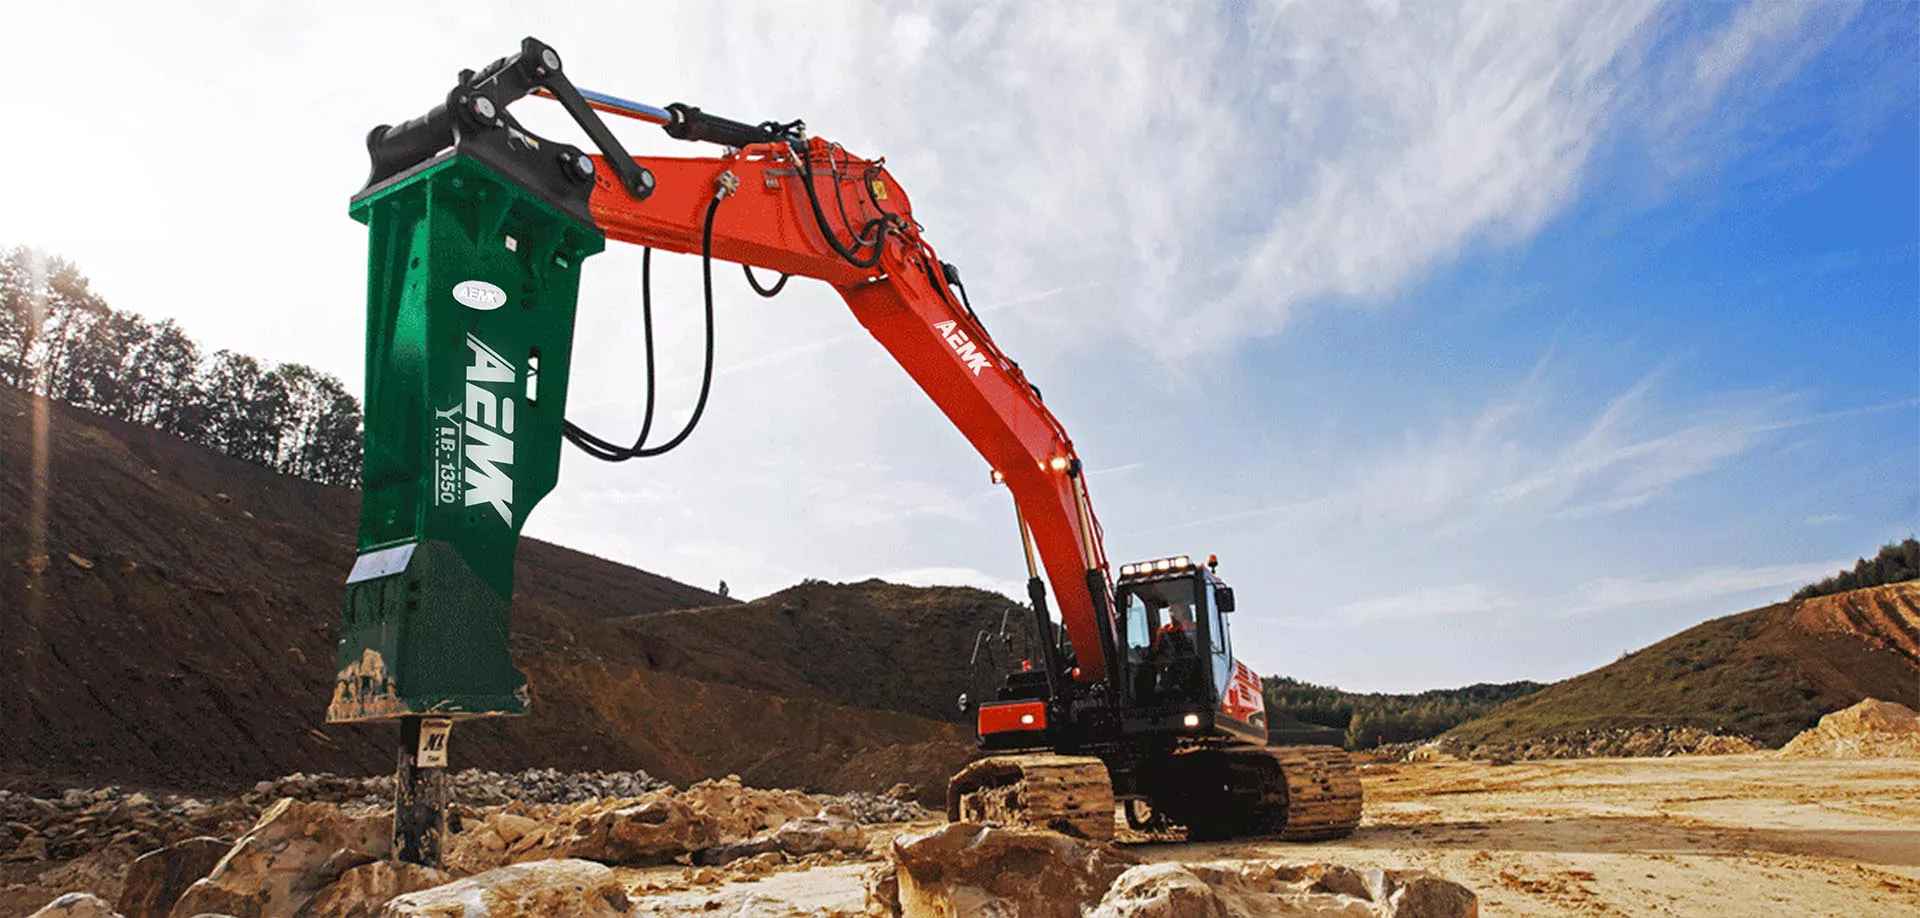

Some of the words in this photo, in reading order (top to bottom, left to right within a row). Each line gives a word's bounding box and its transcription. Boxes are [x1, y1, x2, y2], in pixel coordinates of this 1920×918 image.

[458, 286, 499, 304] AEMK
[933, 319, 993, 377] AEMK
[464, 331, 516, 529] AEMK
